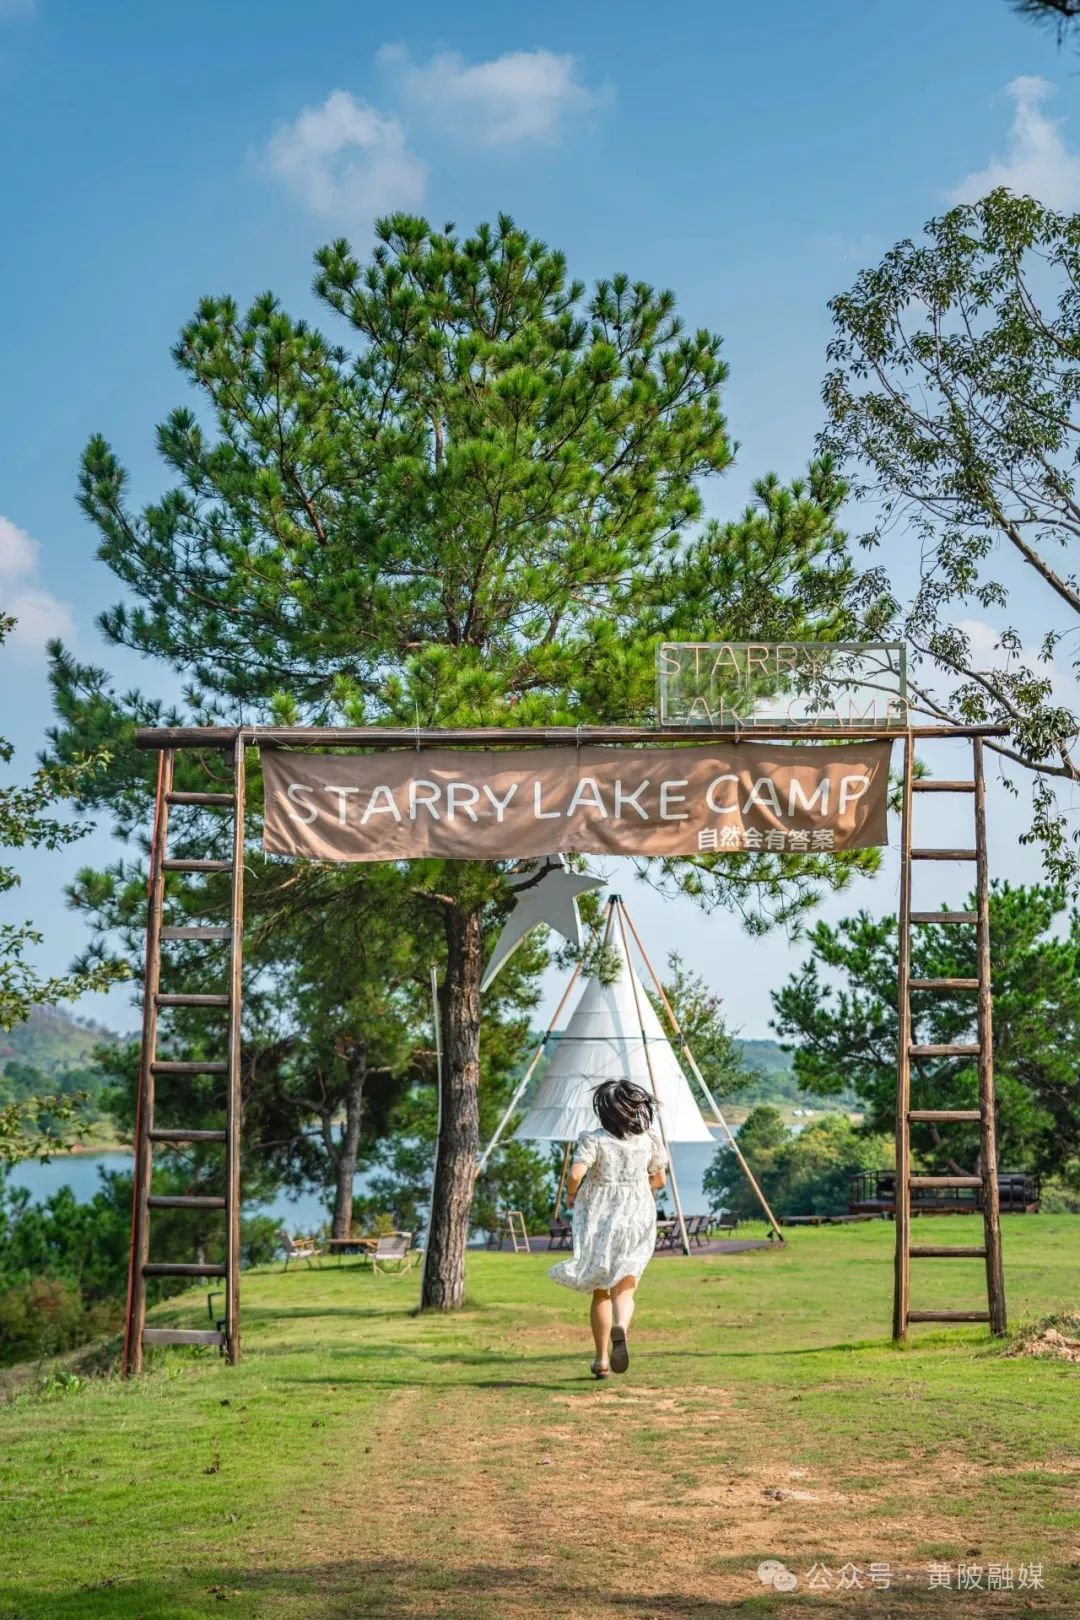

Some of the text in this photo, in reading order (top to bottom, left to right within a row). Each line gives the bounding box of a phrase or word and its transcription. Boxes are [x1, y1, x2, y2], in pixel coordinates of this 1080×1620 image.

[659, 645, 828, 677] STARRY
[660, 697, 909, 727] LAKE CAMP
[287, 774, 870, 825] STARRY LAKE CAMP
[698, 828, 834, 851] 自然会有答案
